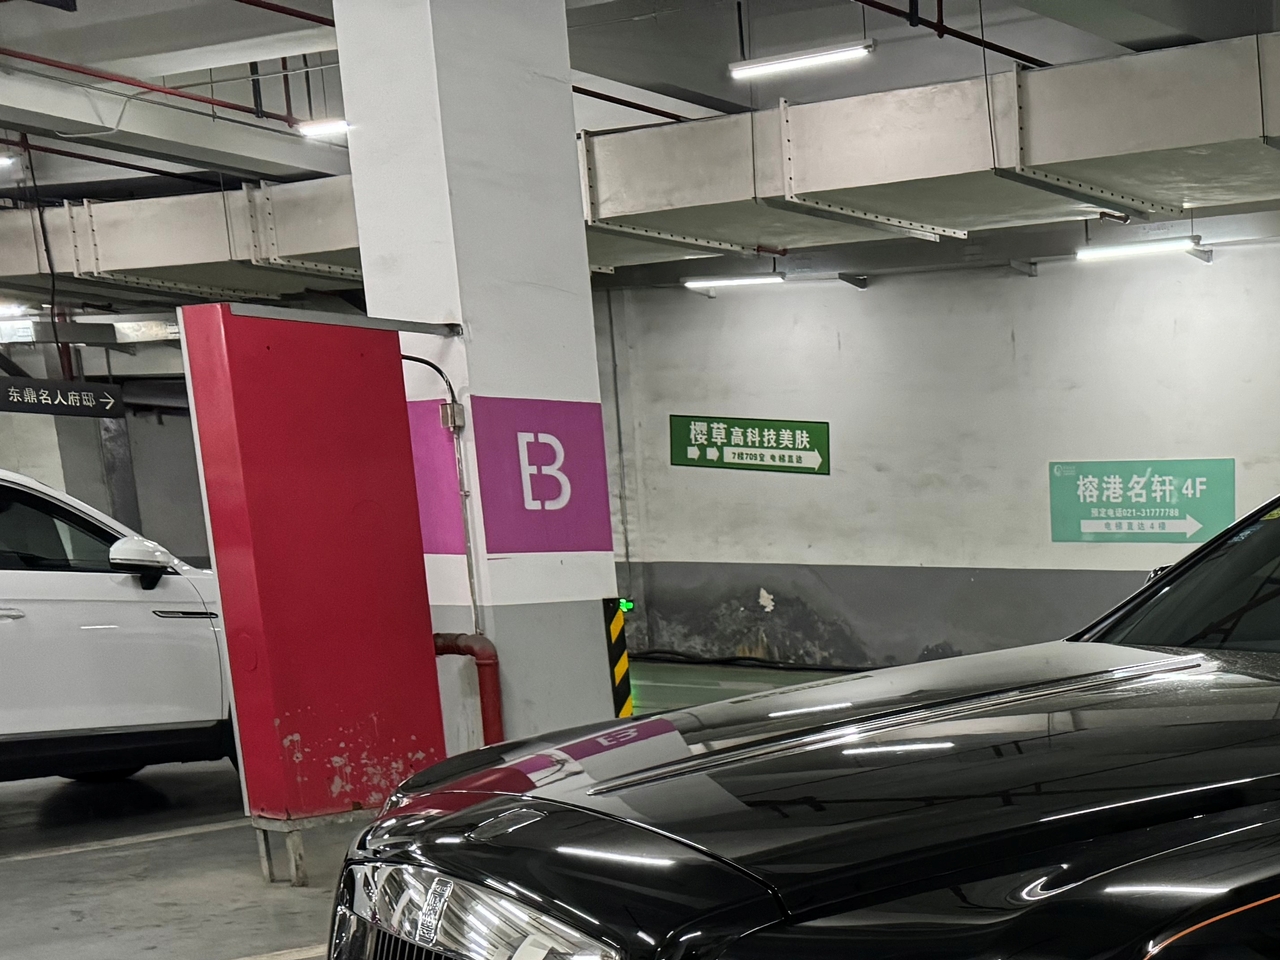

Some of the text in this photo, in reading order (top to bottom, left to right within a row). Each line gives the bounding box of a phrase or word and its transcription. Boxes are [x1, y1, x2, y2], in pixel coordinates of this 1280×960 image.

[7, 385, 96, 408] 东鼎名人府邸
[689, 421, 811, 449] 樱草高科技美肤
[517, 431, 571, 510] B
[1076, 474, 1207, 503] 榕港名轩 4F
